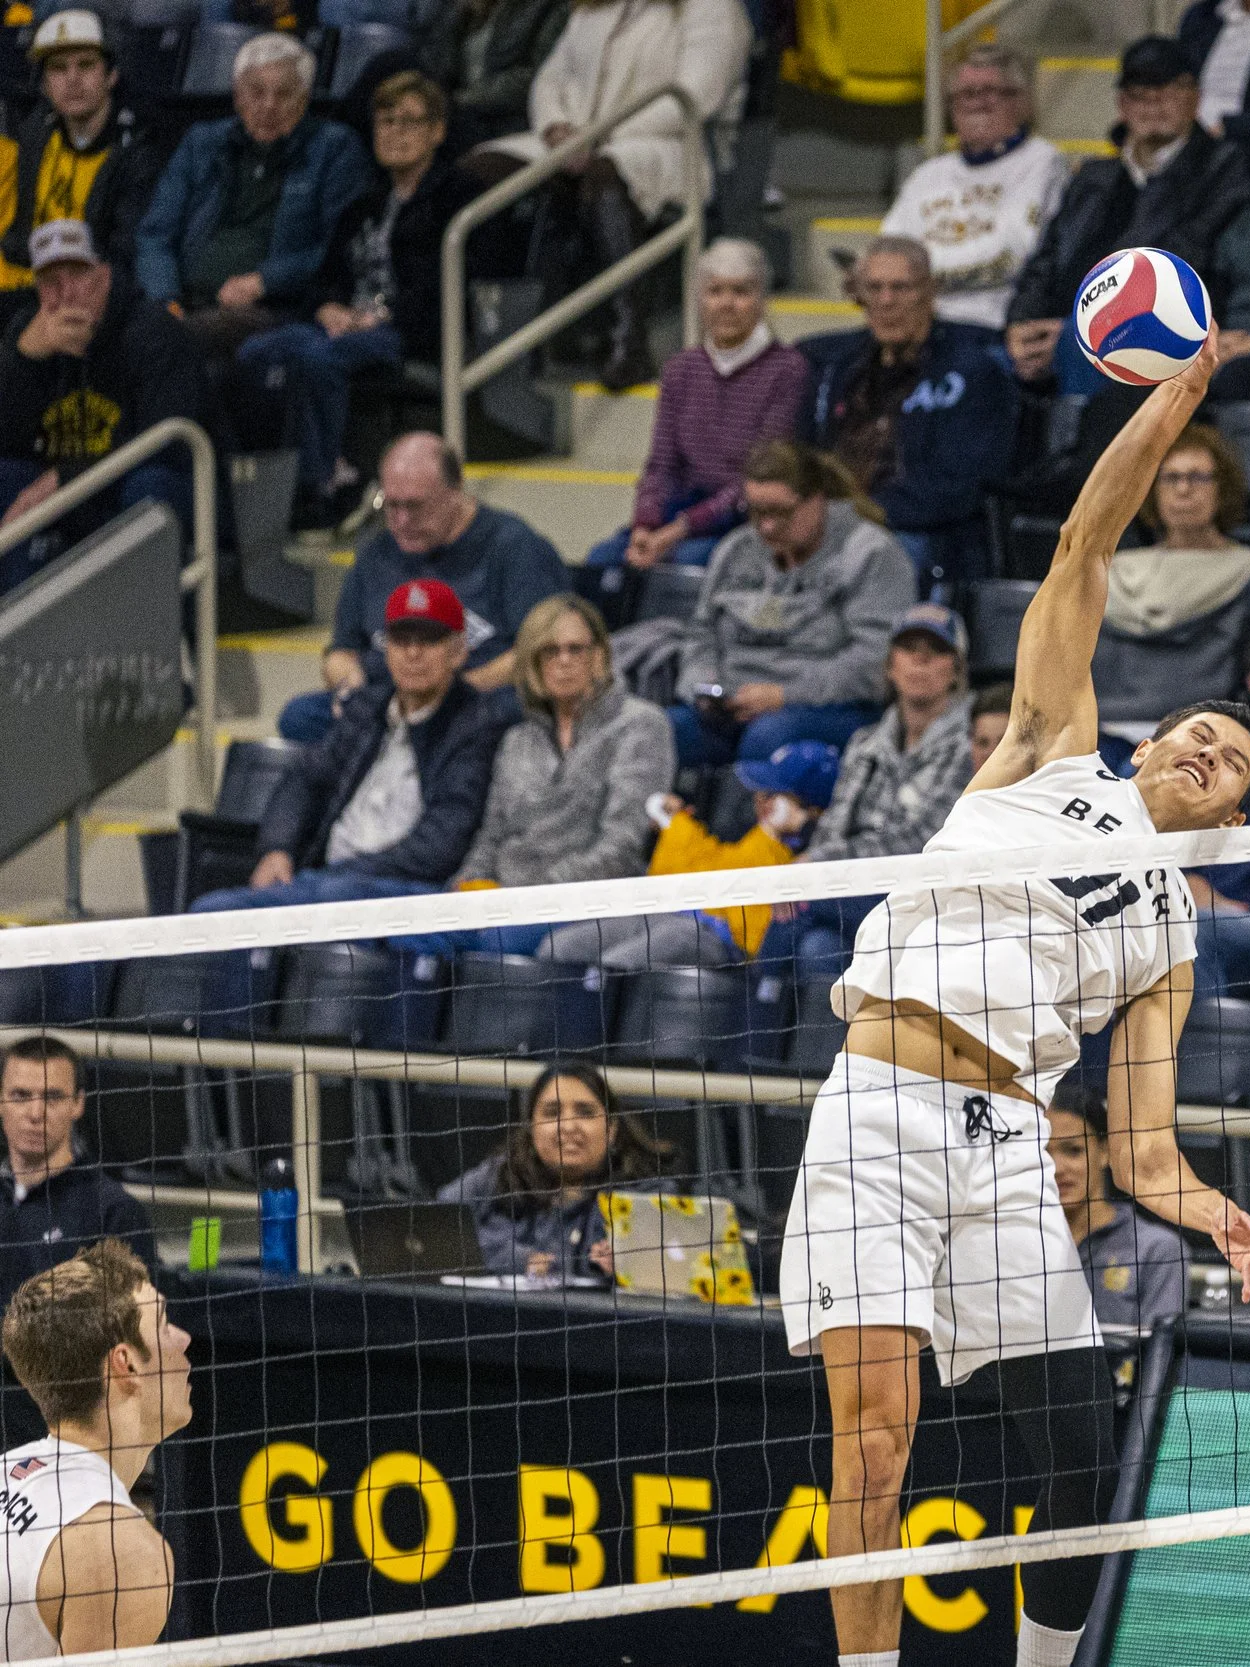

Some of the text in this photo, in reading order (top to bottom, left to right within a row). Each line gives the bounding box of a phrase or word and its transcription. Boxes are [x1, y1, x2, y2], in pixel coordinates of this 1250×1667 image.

[1081, 274, 1119, 312] NCAA
[239, 1441, 1034, 1636] GO BEAC
